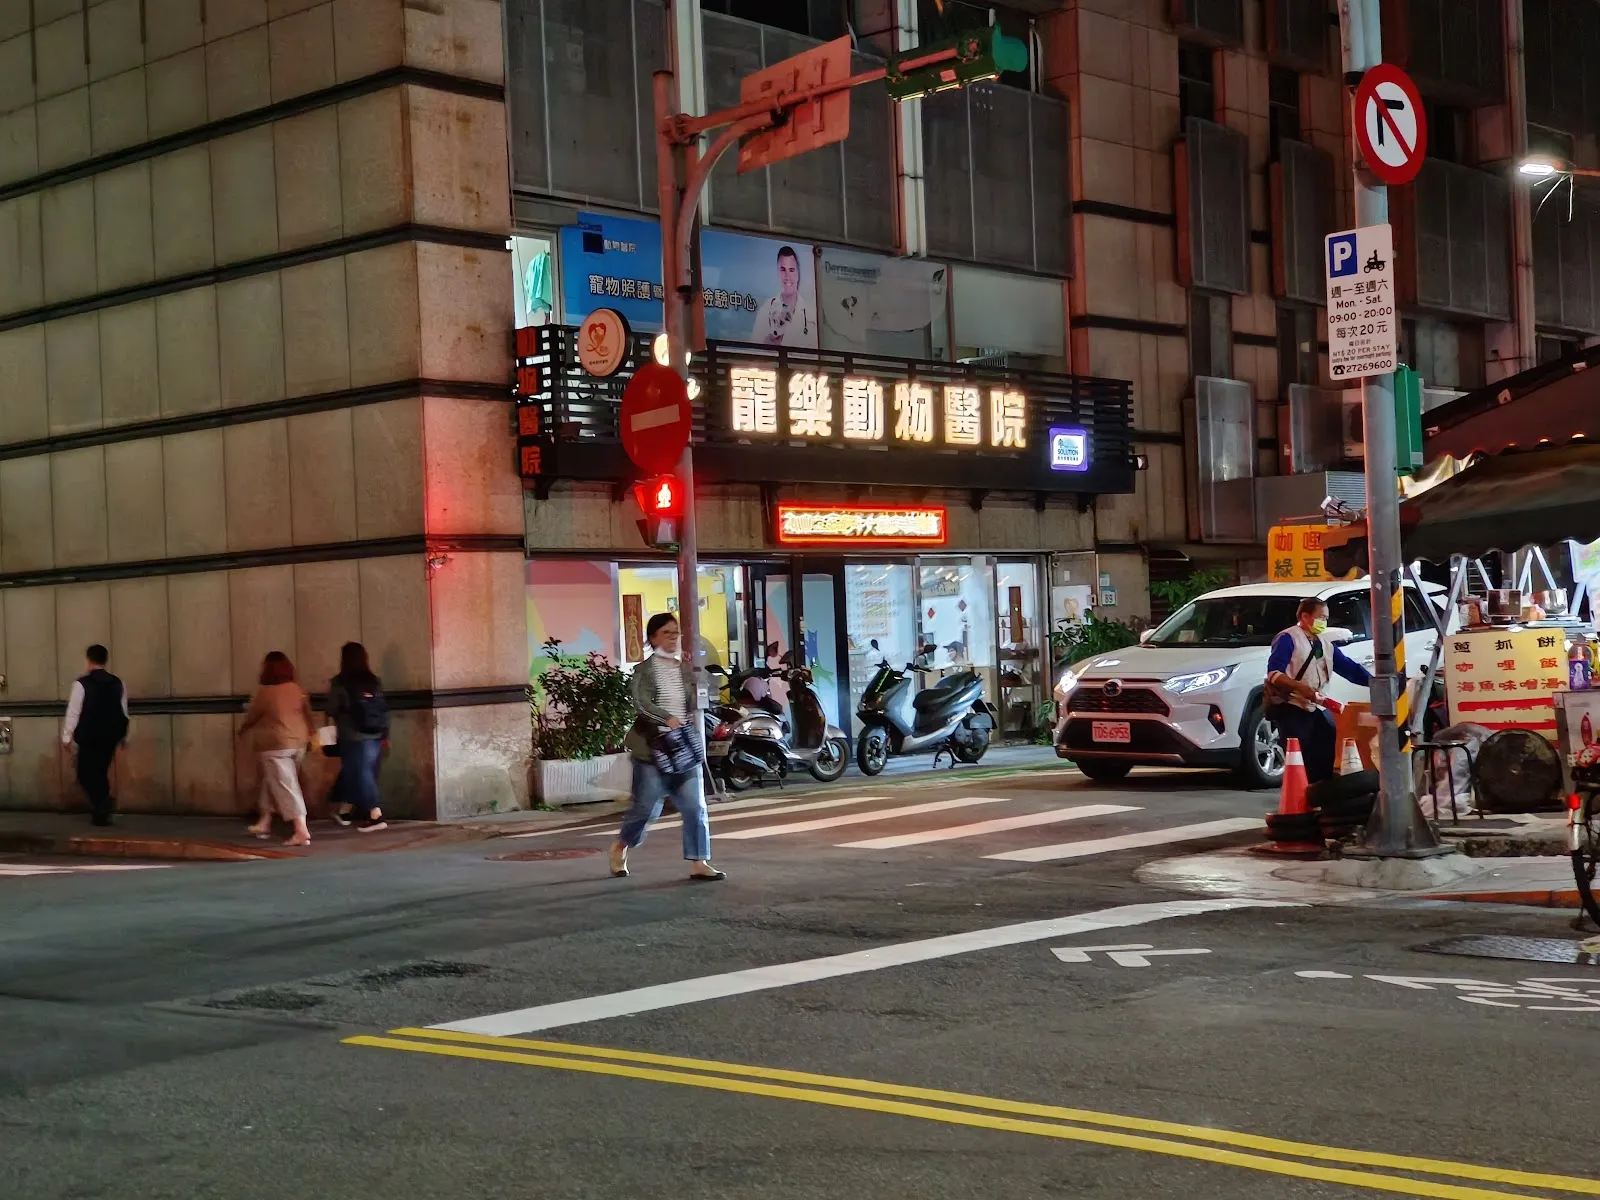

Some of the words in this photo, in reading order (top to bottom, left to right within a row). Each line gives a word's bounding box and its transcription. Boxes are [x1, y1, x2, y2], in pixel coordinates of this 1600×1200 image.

[1333, 241, 1352, 272] P
[1331, 279, 1389, 299] 週一至週六
[1346, 348, 1356, 356] 20
[1357, 346, 1371, 354] PER
[1372, 343, 1391, 352] STAY
[1346, 359, 1392, 373] 27269600
[730, 367, 1027, 449] 寵樂動物醫院
